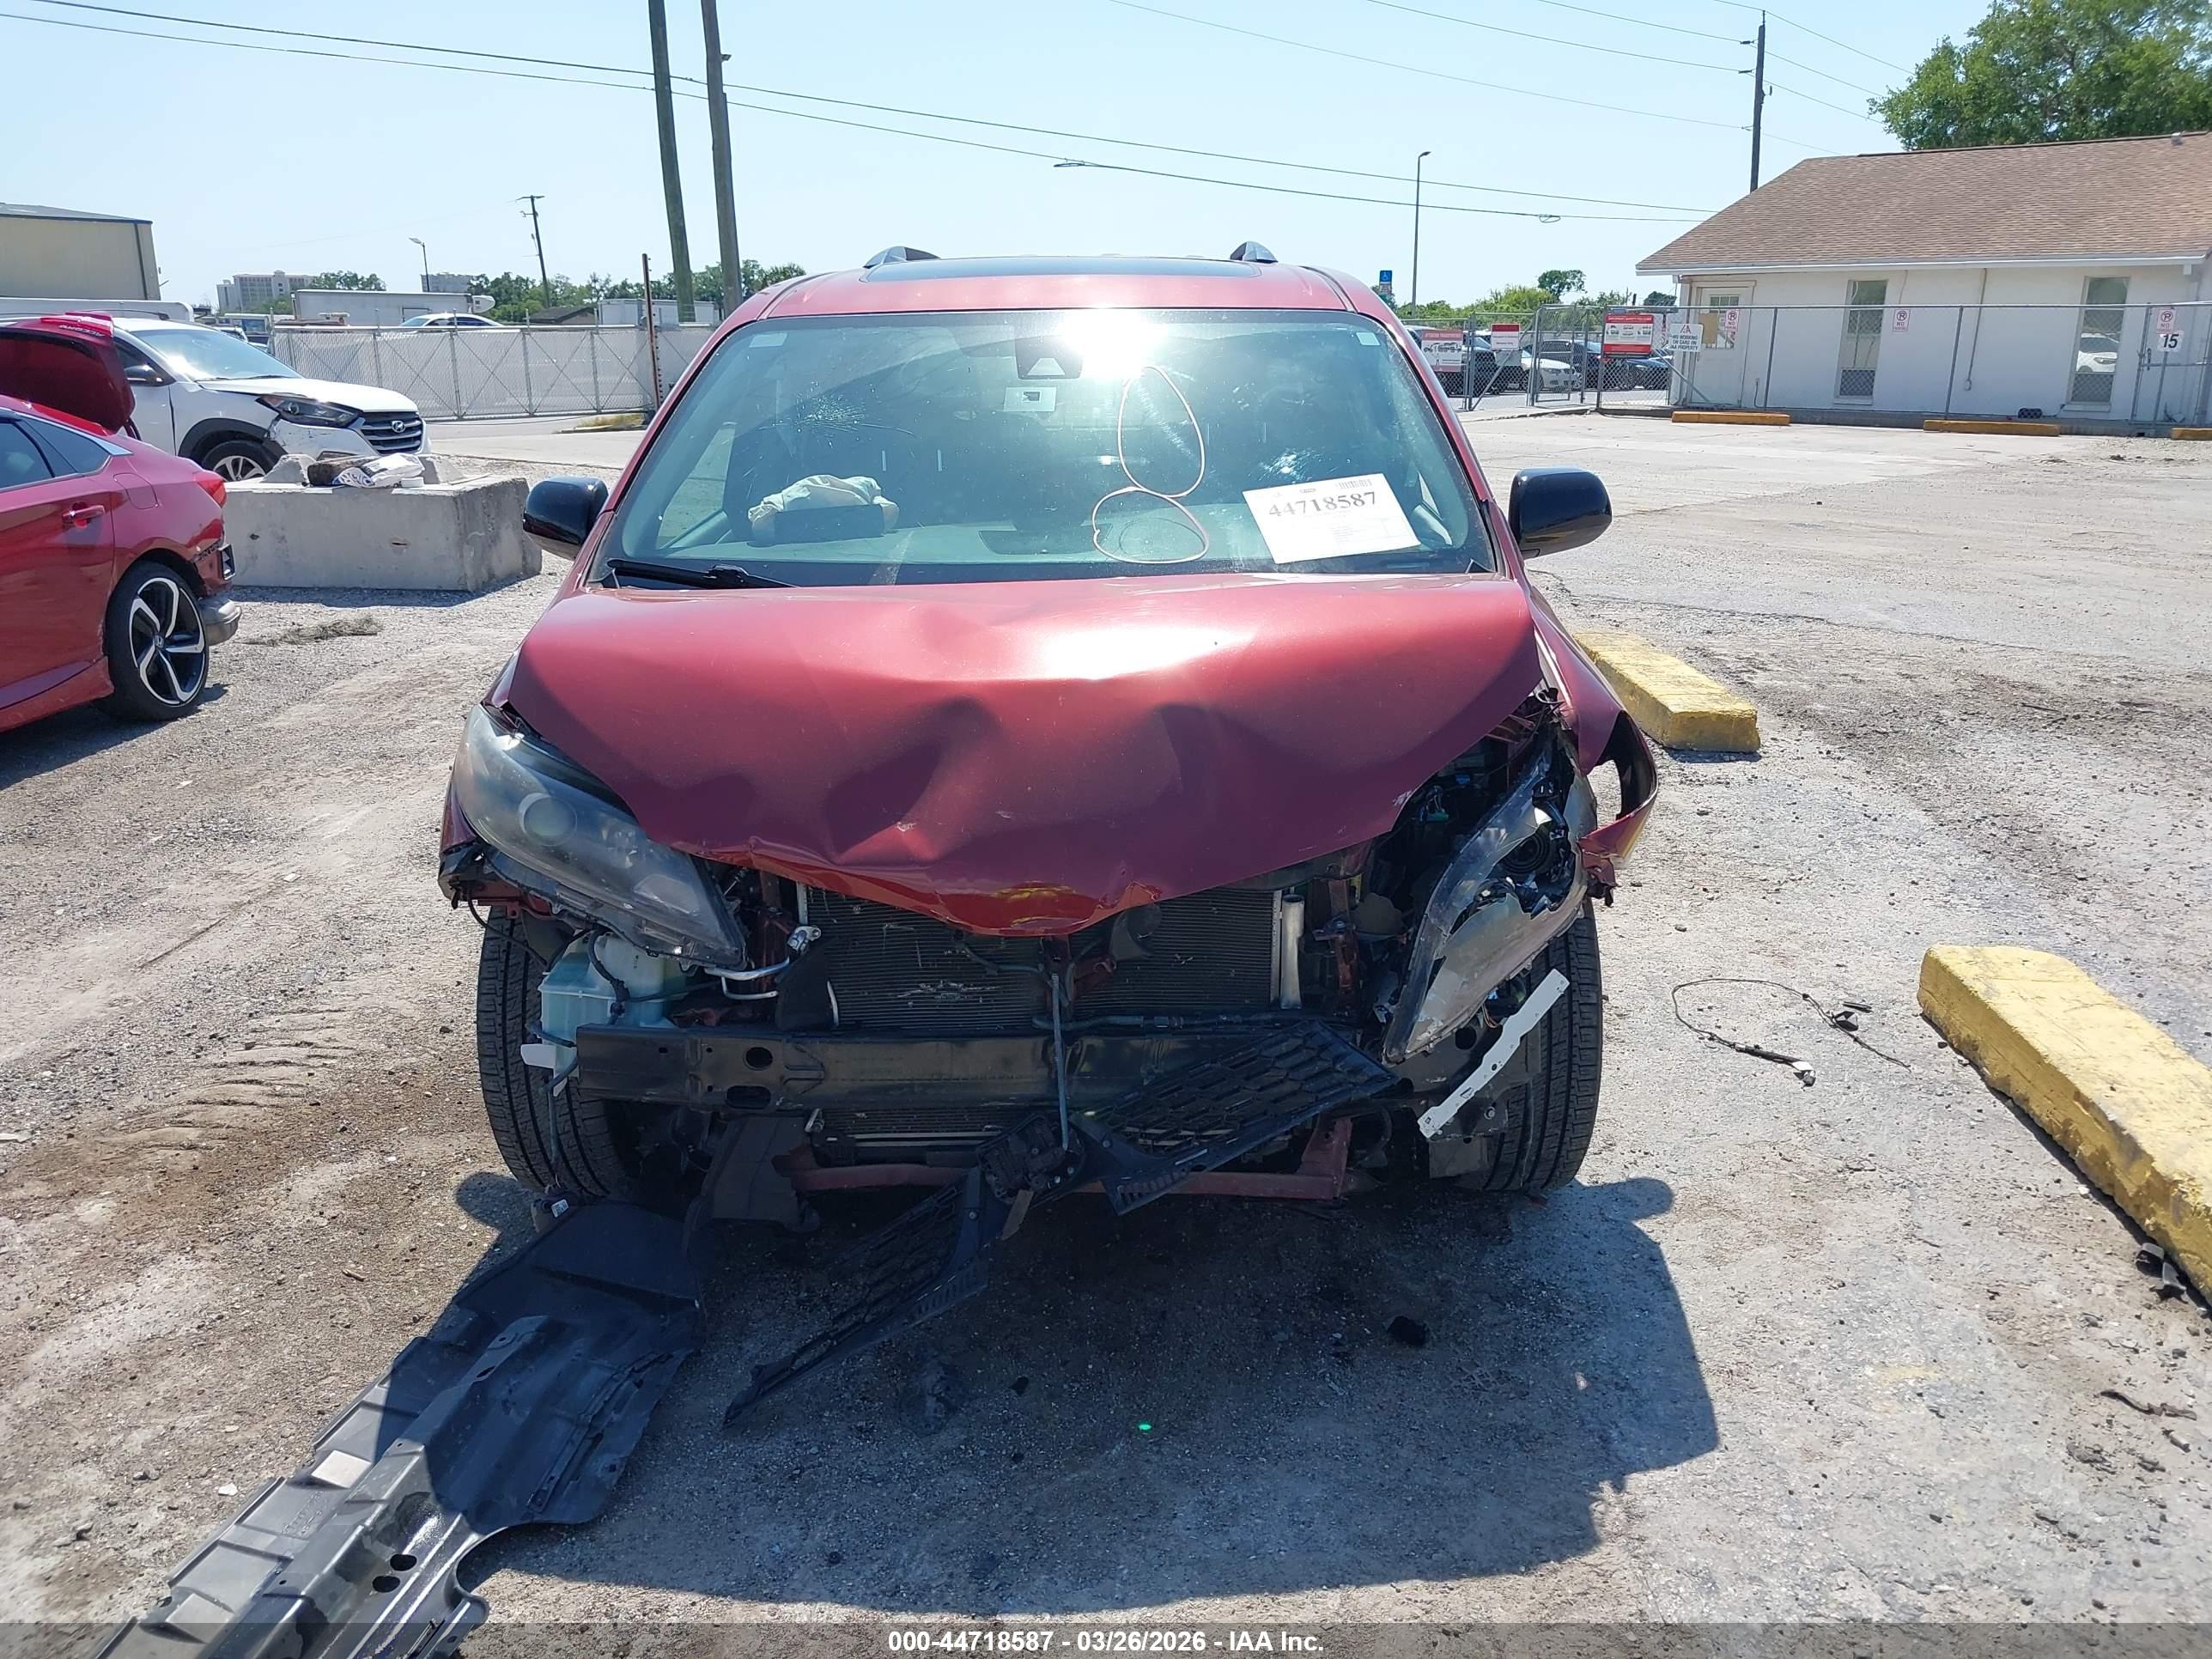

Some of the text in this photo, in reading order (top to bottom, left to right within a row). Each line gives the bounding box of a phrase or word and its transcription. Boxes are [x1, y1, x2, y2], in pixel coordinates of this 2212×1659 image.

[58, 325, 105, 337] ACCORD
[2163, 333, 2179, 348] 15
[1268, 491, 1377, 517] 44718587
